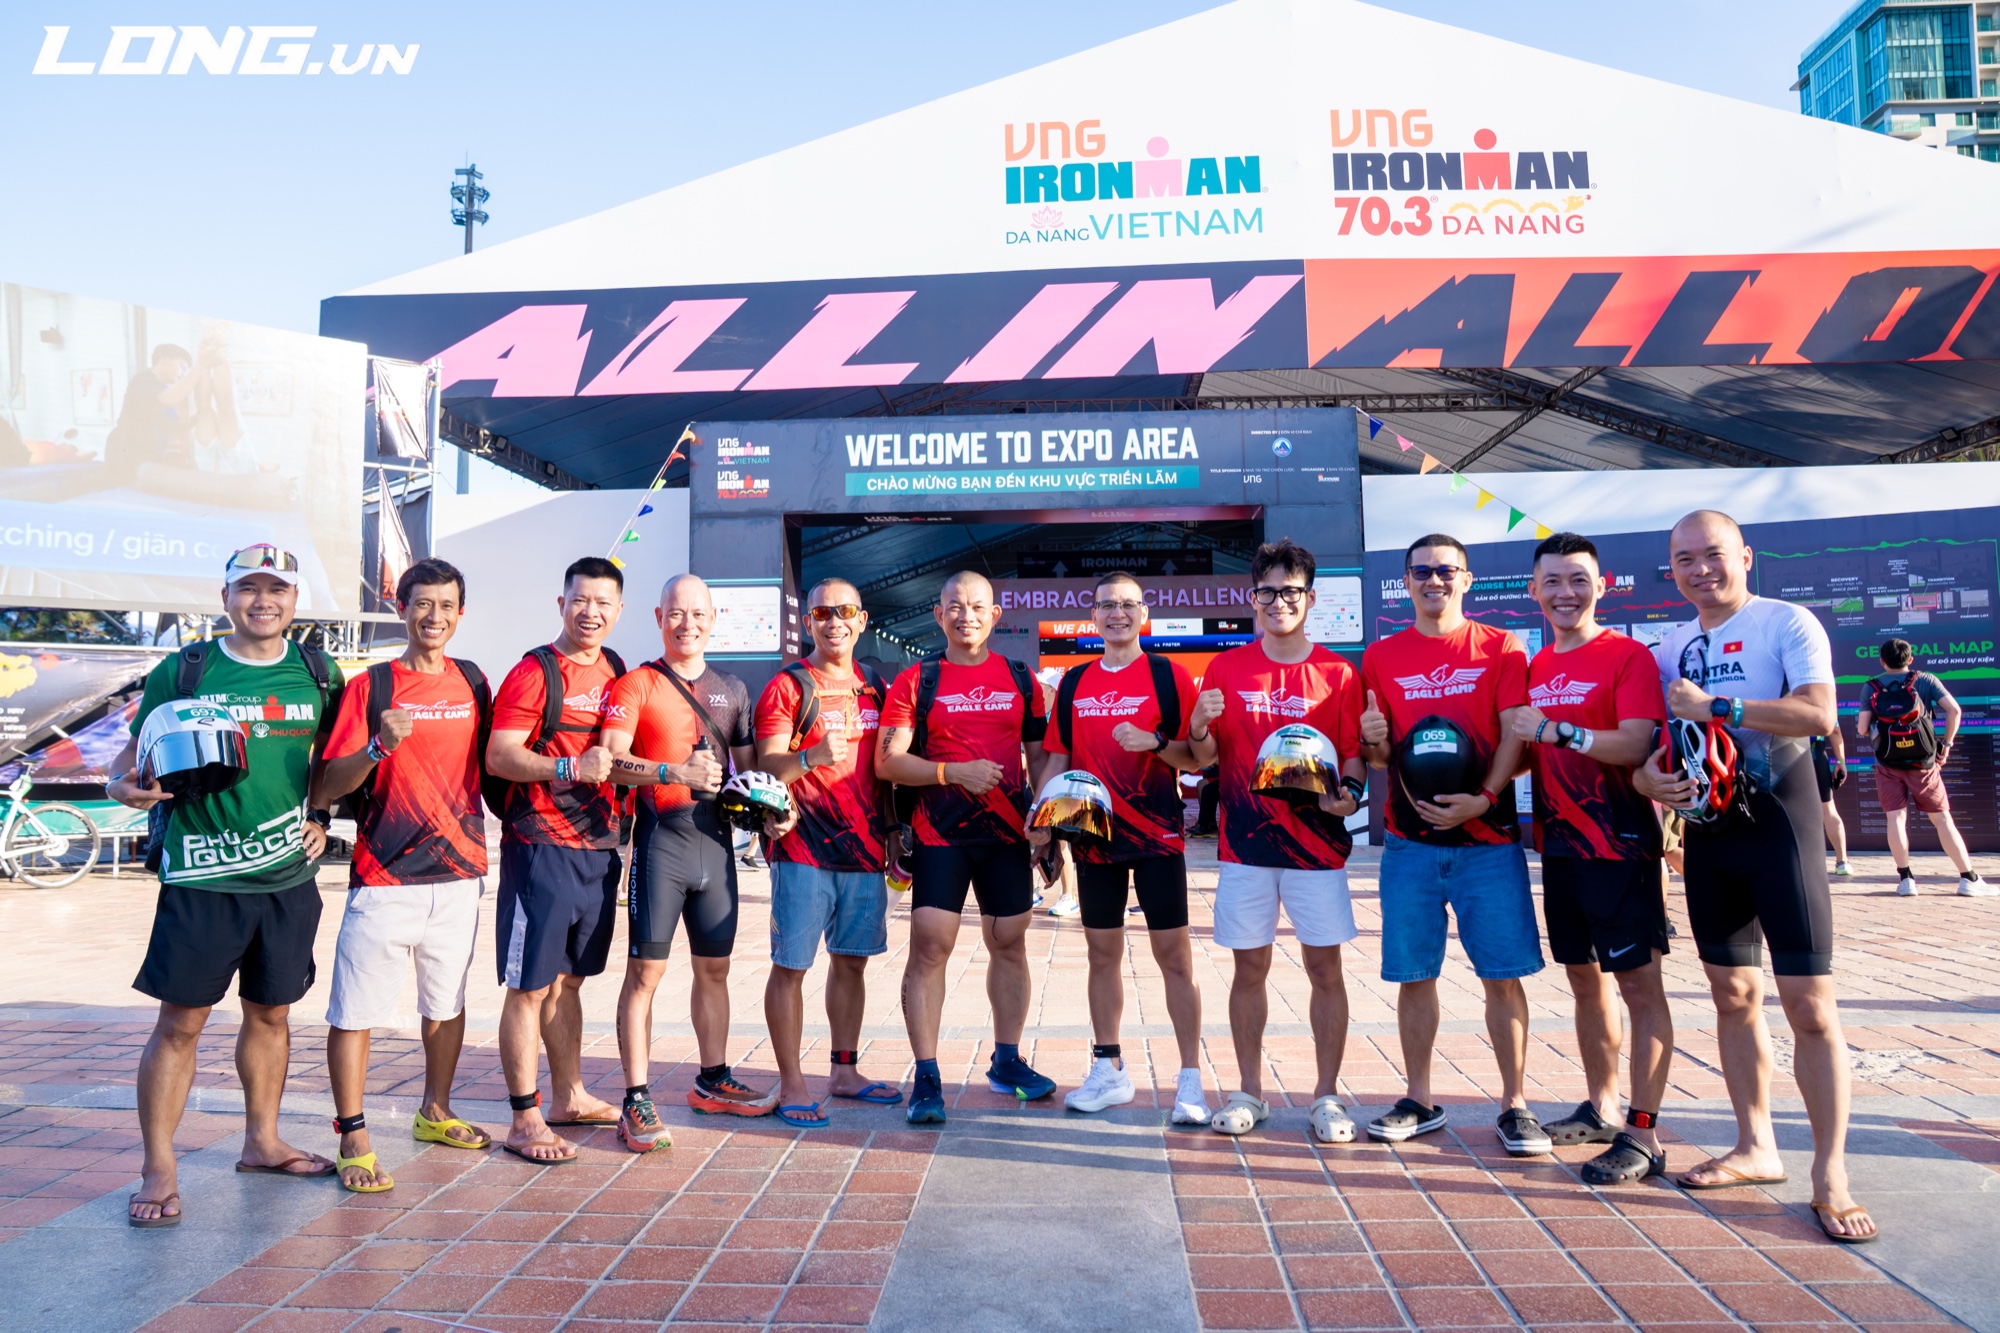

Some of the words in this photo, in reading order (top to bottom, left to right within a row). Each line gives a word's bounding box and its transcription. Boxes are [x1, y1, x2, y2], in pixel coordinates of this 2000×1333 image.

[1330, 109, 1433, 148] VNG
[1004, 120, 1106, 161] VNG
[1333, 129, 1591, 191] IRONMAN
[1005, 137, 1262, 205] IRONMAN
[1335, 196, 1432, 236] 70.3
[1442, 215, 1485, 236] DA
[1494, 214, 1585, 236] NANG
[1005, 231, 1034, 244] DA
[1037, 227, 1090, 243] NANG
[1090, 207, 1263, 241] VIETNAM
[1309, 269, 1774, 369] ALL
[365, 290, 918, 397] ALL
[944, 275, 1305, 384] IN
[718, 438, 739, 447] VNG
[718, 441, 770, 457] IRONMAN
[845, 432, 987, 467] WELCOME
[996, 431, 1032, 464] TO
[1042, 429, 1113, 463] EXPO
[1122, 427, 1199, 460] AREA
[735, 457, 770, 465] VIETNAM
[718, 471, 739, 480] VNG
[718, 475, 770, 489] IRONMAN
[867, 476, 908, 491] CHÀO
[912, 473, 957, 490] MỪNG
[961, 476, 991, 492] BẠN
[995, 471, 1026, 488] ĐẾN
[1030, 474, 1061, 488] KHU
[1064, 472, 1096, 490] VỰC
[1099, 469, 1142, 486] TRIỂN
[1146, 469, 1177, 485] LÃM
[1243, 475, 1262, 483] VNG
[1081, 557, 1148, 568] IRONMAN
[1381, 579, 1404, 590] VNG
[1507, 580, 1528, 589] MAP
[1001, 590, 1094, 610] EMBRAC
[1382, 589, 1411, 600] IRON
[1053, 624, 1075, 634] WE
[1949, 641, 1994, 654] MAP
[1404, 688, 1442, 700] EAGLE
[1444, 684, 1476, 696] CAMP
[223, 695, 314, 721] ONMAN
[947, 704, 982, 713] EAGLE
[984, 702, 1013, 712] CAMP
[1531, 698, 1558, 708] EAGLE
[1559, 696, 1585, 705] CAMP
[190, 708, 218, 718] 692
[444, 710, 471, 719] CAMP
[1078, 709, 1109, 718] EAGLE
[1111, 707, 1139, 716] CAMP
[1246, 704, 1279, 715] EAGLE
[1281, 708, 1306, 718] CAMP
[856, 721, 879, 730] CAMP
[1422, 730, 1447, 741] 069
[615, 758, 645, 772] 463
[760, 791, 780, 806] 463
[630, 866, 638, 915] BIONIC
